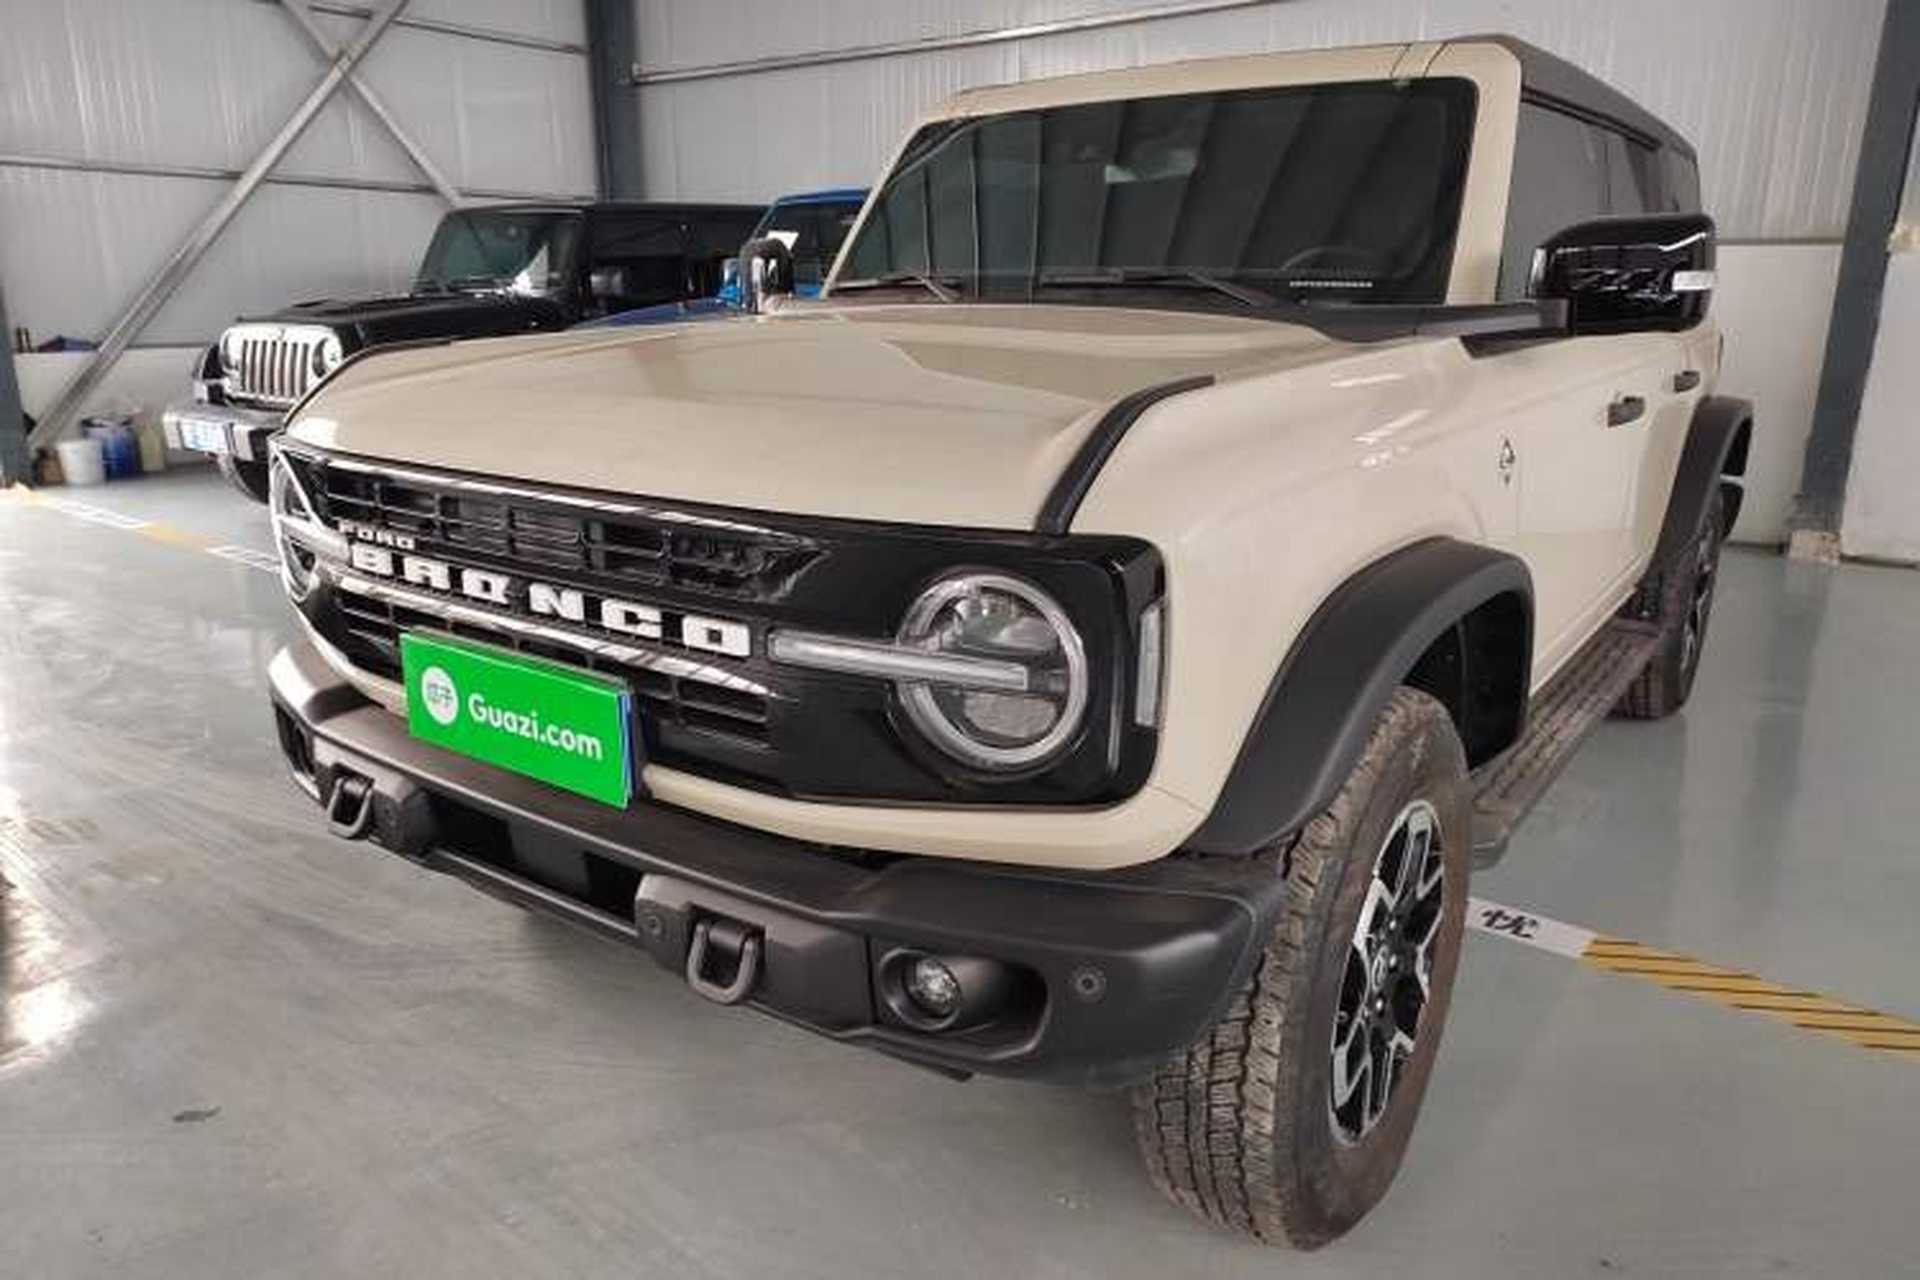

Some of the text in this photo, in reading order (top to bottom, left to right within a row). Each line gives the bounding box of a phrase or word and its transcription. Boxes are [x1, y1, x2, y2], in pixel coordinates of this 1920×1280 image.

[339, 520, 415, 549] FORD
[351, 544, 750, 657] BRONCO
[468, 693, 602, 761] Guazi.com
